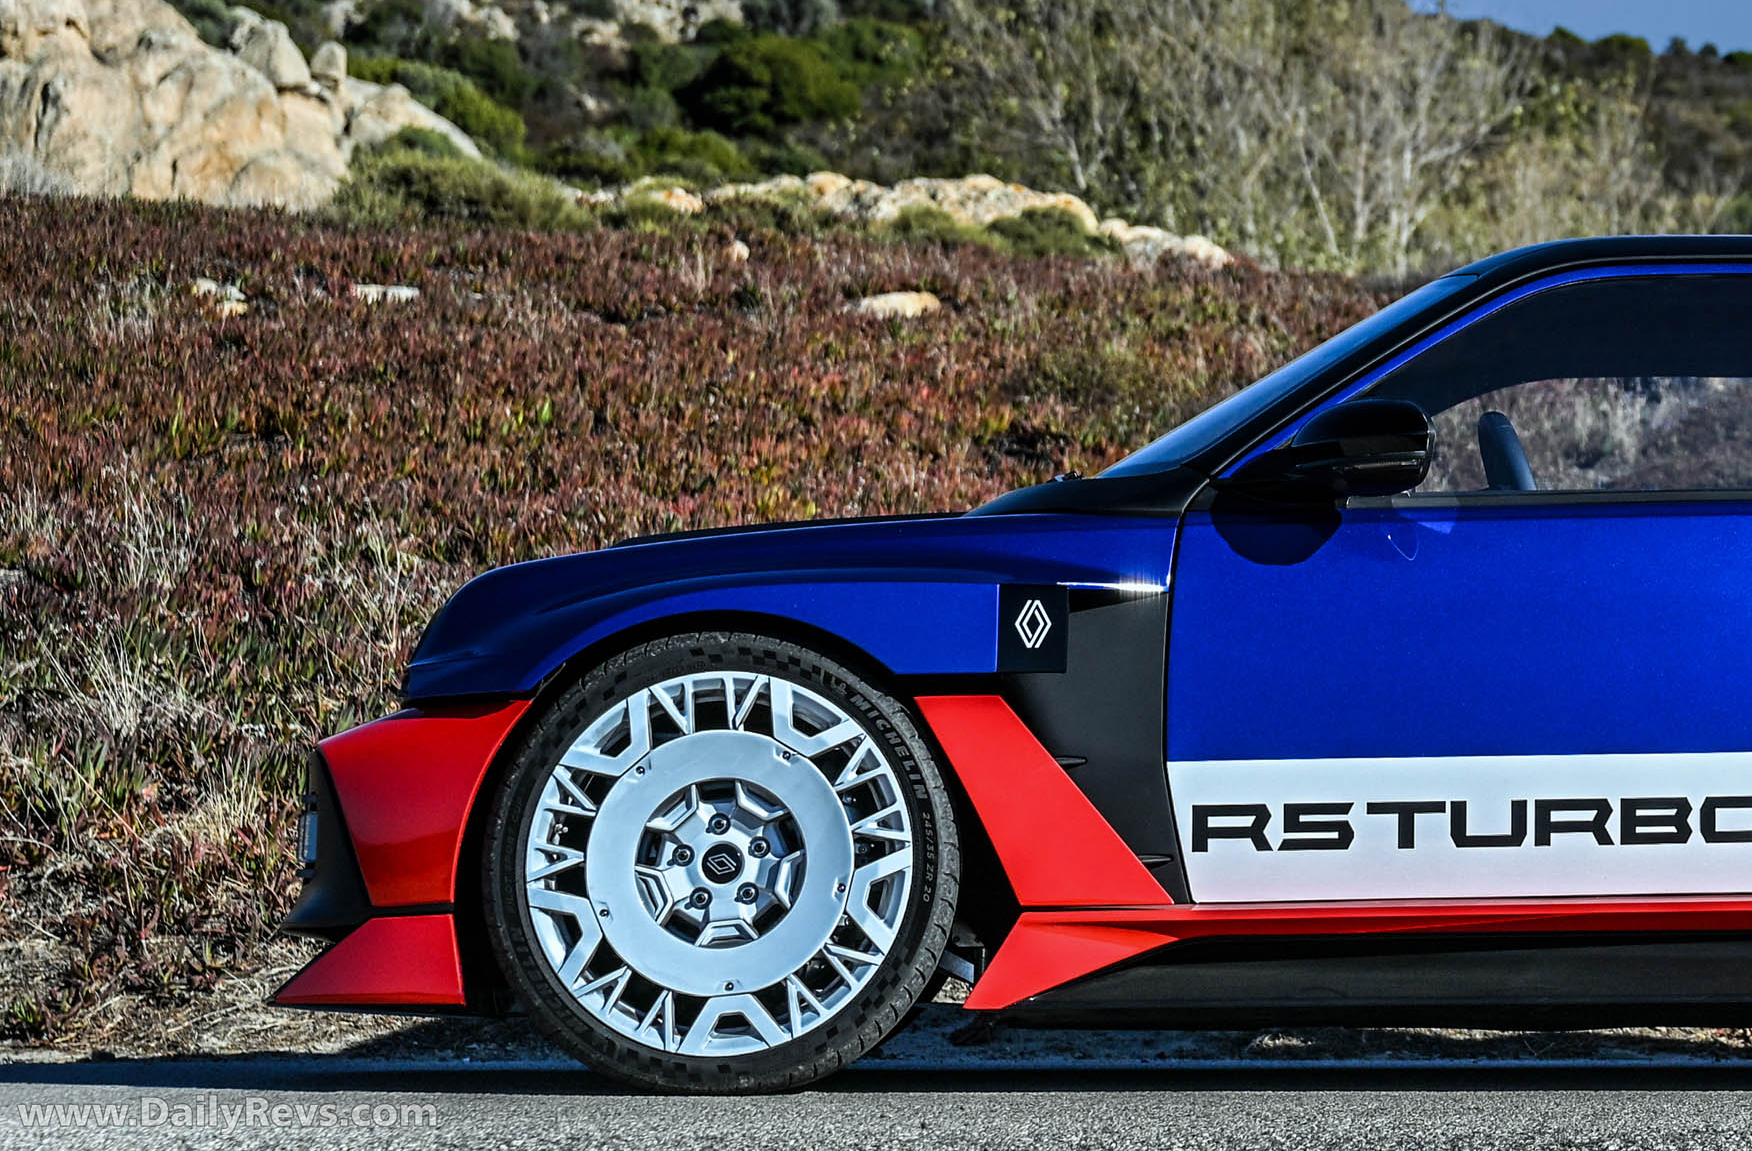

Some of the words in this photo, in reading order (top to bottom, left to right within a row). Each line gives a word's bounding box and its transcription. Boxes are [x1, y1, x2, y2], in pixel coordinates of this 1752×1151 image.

[849, 694, 928, 799] MICHELIN
[922, 811, 935, 859] 245/35
[925, 862, 934, 881] ZR
[922, 886, 932, 903] 20
